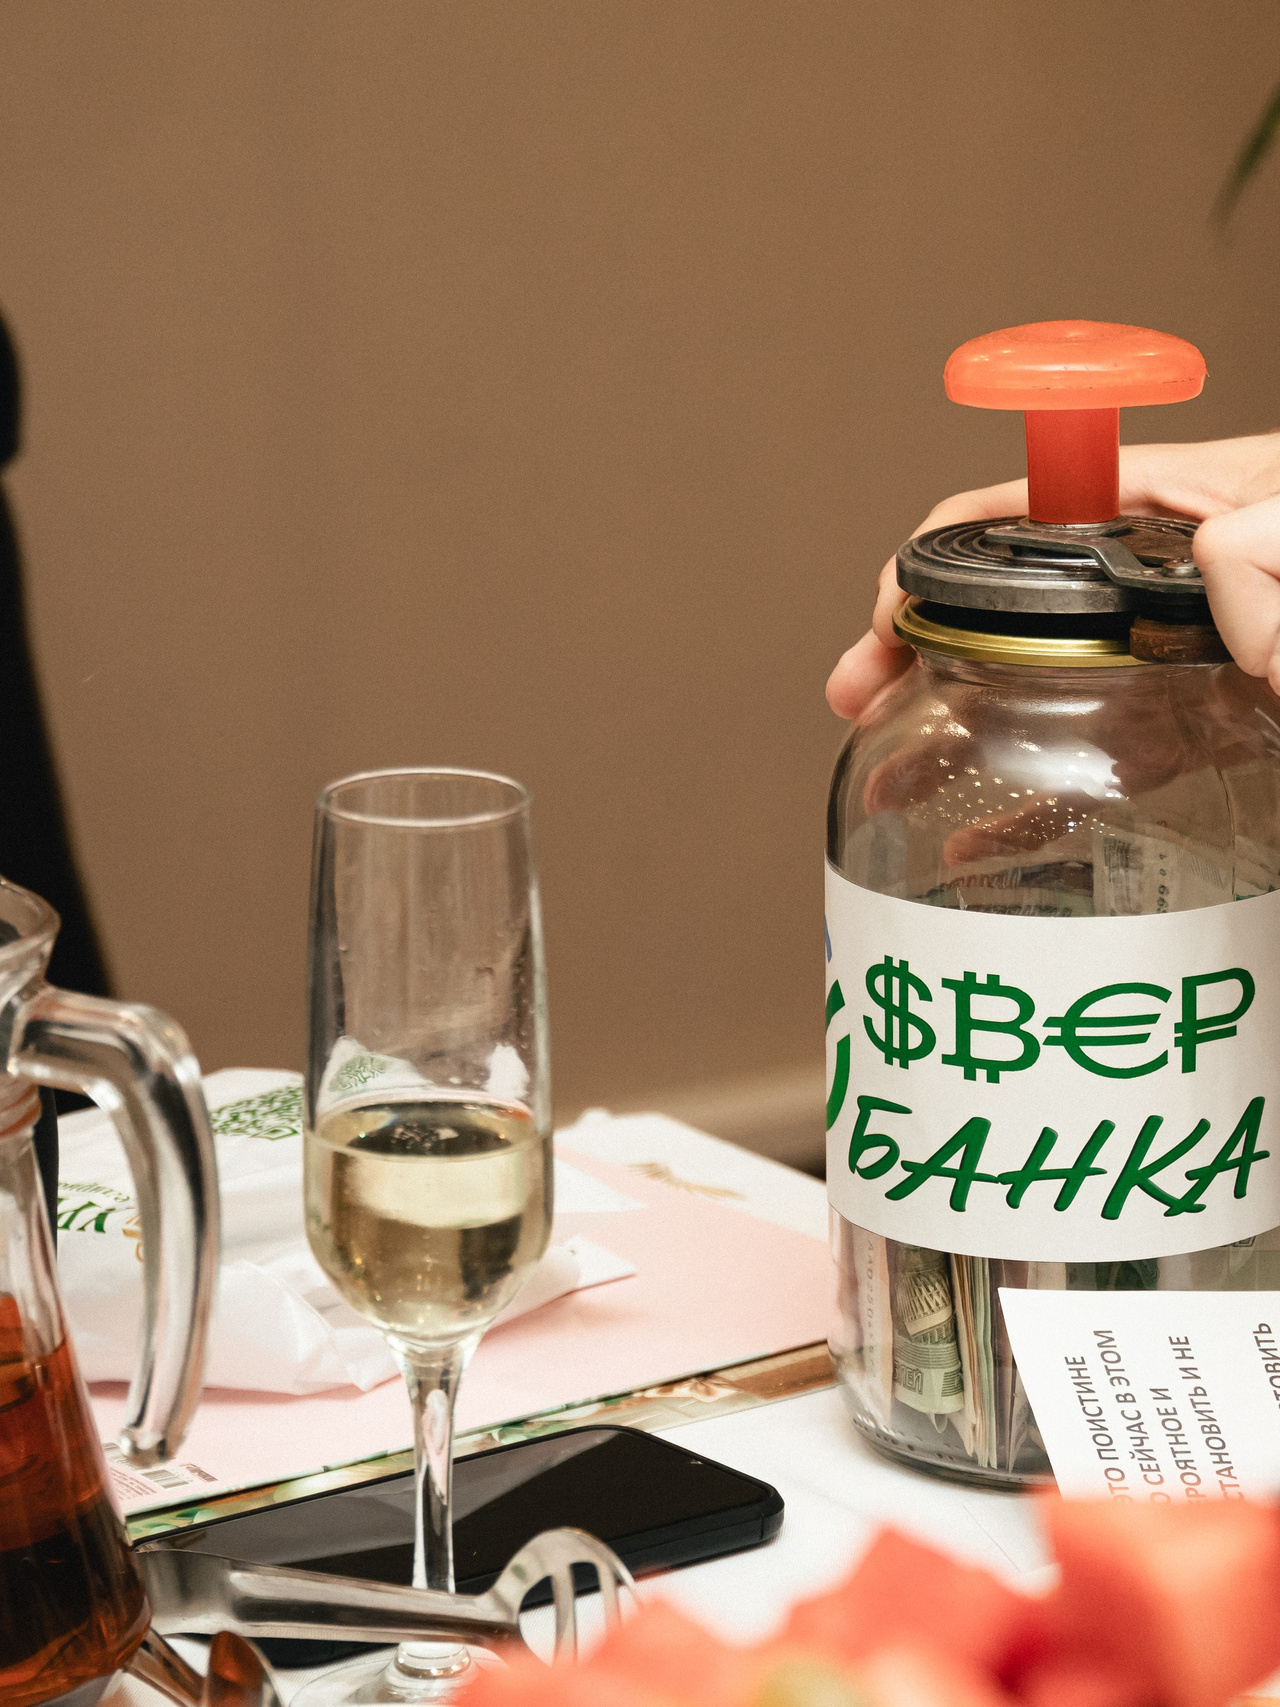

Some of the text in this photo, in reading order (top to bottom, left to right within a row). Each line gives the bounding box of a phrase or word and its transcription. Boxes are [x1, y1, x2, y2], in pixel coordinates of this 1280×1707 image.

[848, 1095, 1270, 1220] БАНКА
[1093, 1330, 1130, 1387] ЭТОМ
[1168, 1336, 1194, 1360] НЕ
[1179, 1367, 1202, 1380] И
[1064, 1356, 1119, 1460] ПОИСТИНЕ
[1115, 1393, 1136, 1403] В
[1120, 1410, 1164, 1485] СЕЙЧАС
[1149, 1388, 1207, 1503] РОЯТНОЕ И
